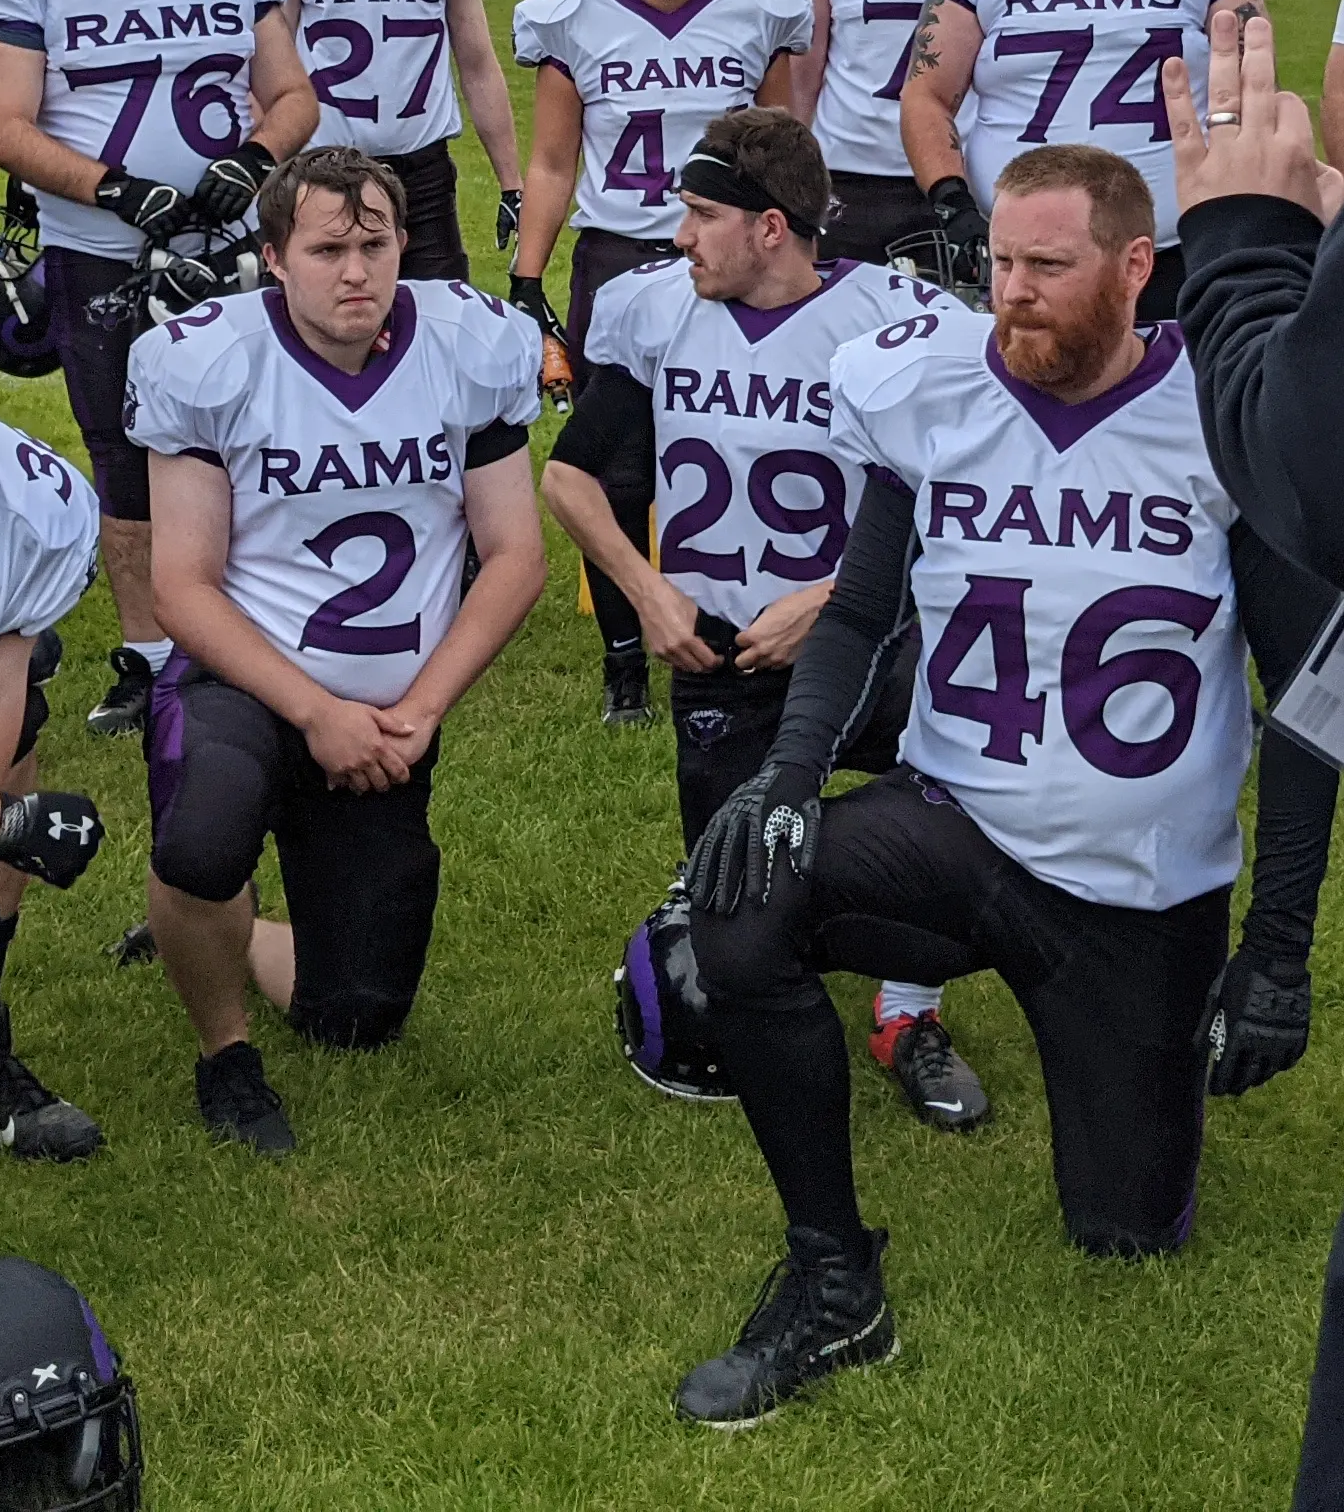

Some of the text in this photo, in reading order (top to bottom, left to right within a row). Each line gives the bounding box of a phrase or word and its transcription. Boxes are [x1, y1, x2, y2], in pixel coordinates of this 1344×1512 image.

[65, 2, 243, 51] RAMS
[304, 18, 445, 123] 27
[61, 53, 247, 176] 76
[599, 56, 745, 95] RAMS
[993, 24, 1184, 143] 74
[163, 301, 221, 345] 2
[663, 367, 831, 429] RAMS
[258, 432, 452, 496] RAMS
[659, 437, 850, 586] 29
[926, 480, 1194, 557] RAMS
[298, 510, 422, 657] 2
[927, 573, 1224, 780] 46
